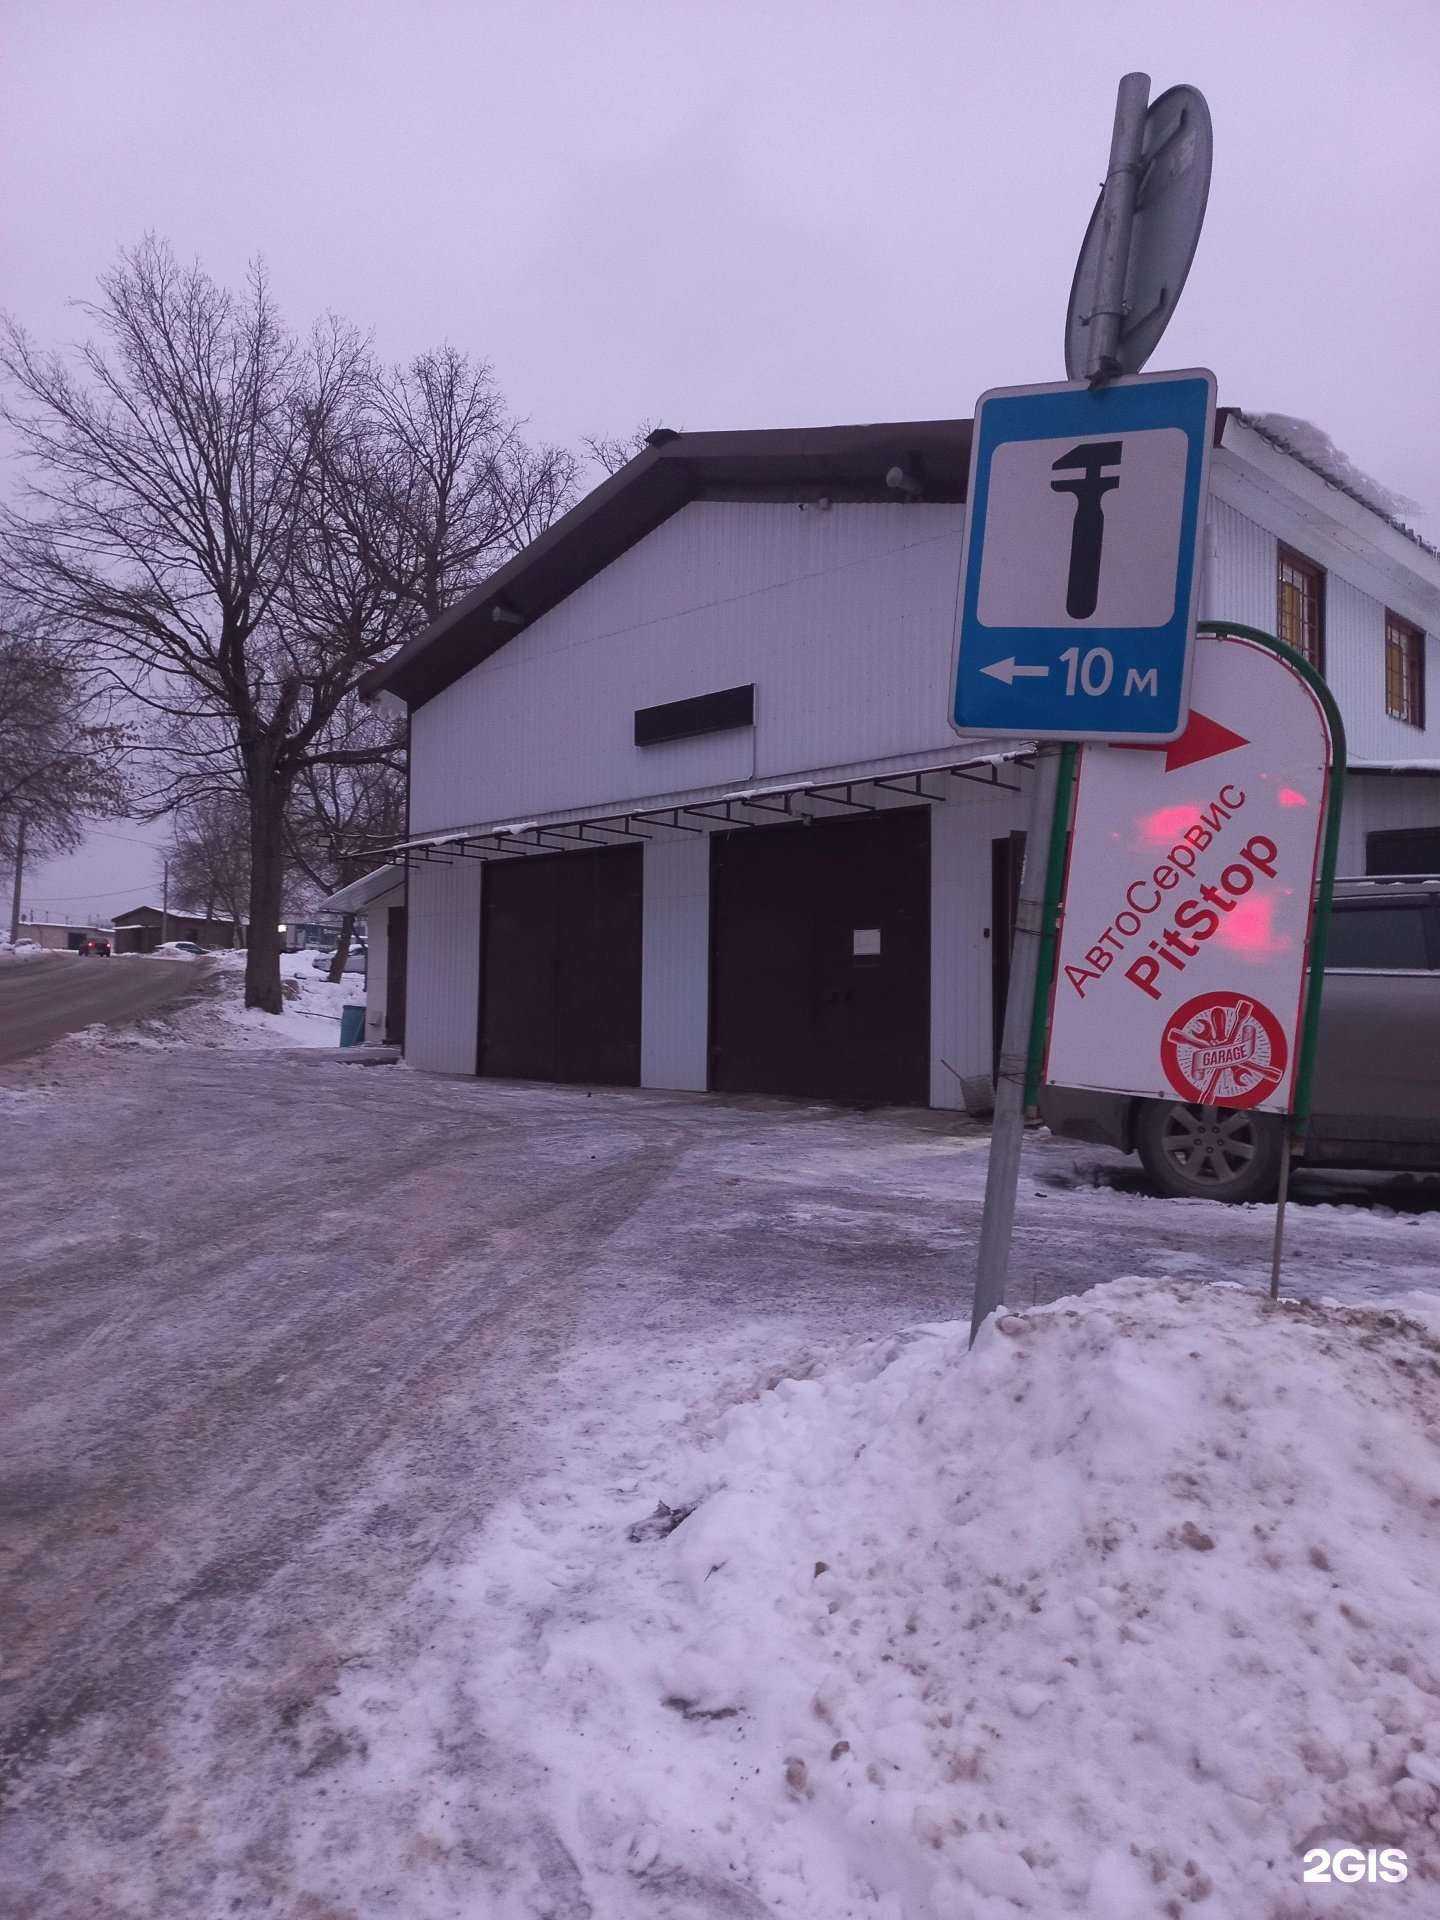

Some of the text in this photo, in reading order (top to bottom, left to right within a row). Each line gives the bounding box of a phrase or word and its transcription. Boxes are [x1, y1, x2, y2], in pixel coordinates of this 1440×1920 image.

[1059, 647, 1113, 697] 10
[1063, 784, 1246, 999] АвтоСервис
[1124, 834, 1279, 1001] PitStop
[1202, 1045, 1247, 1066] GARAGE
